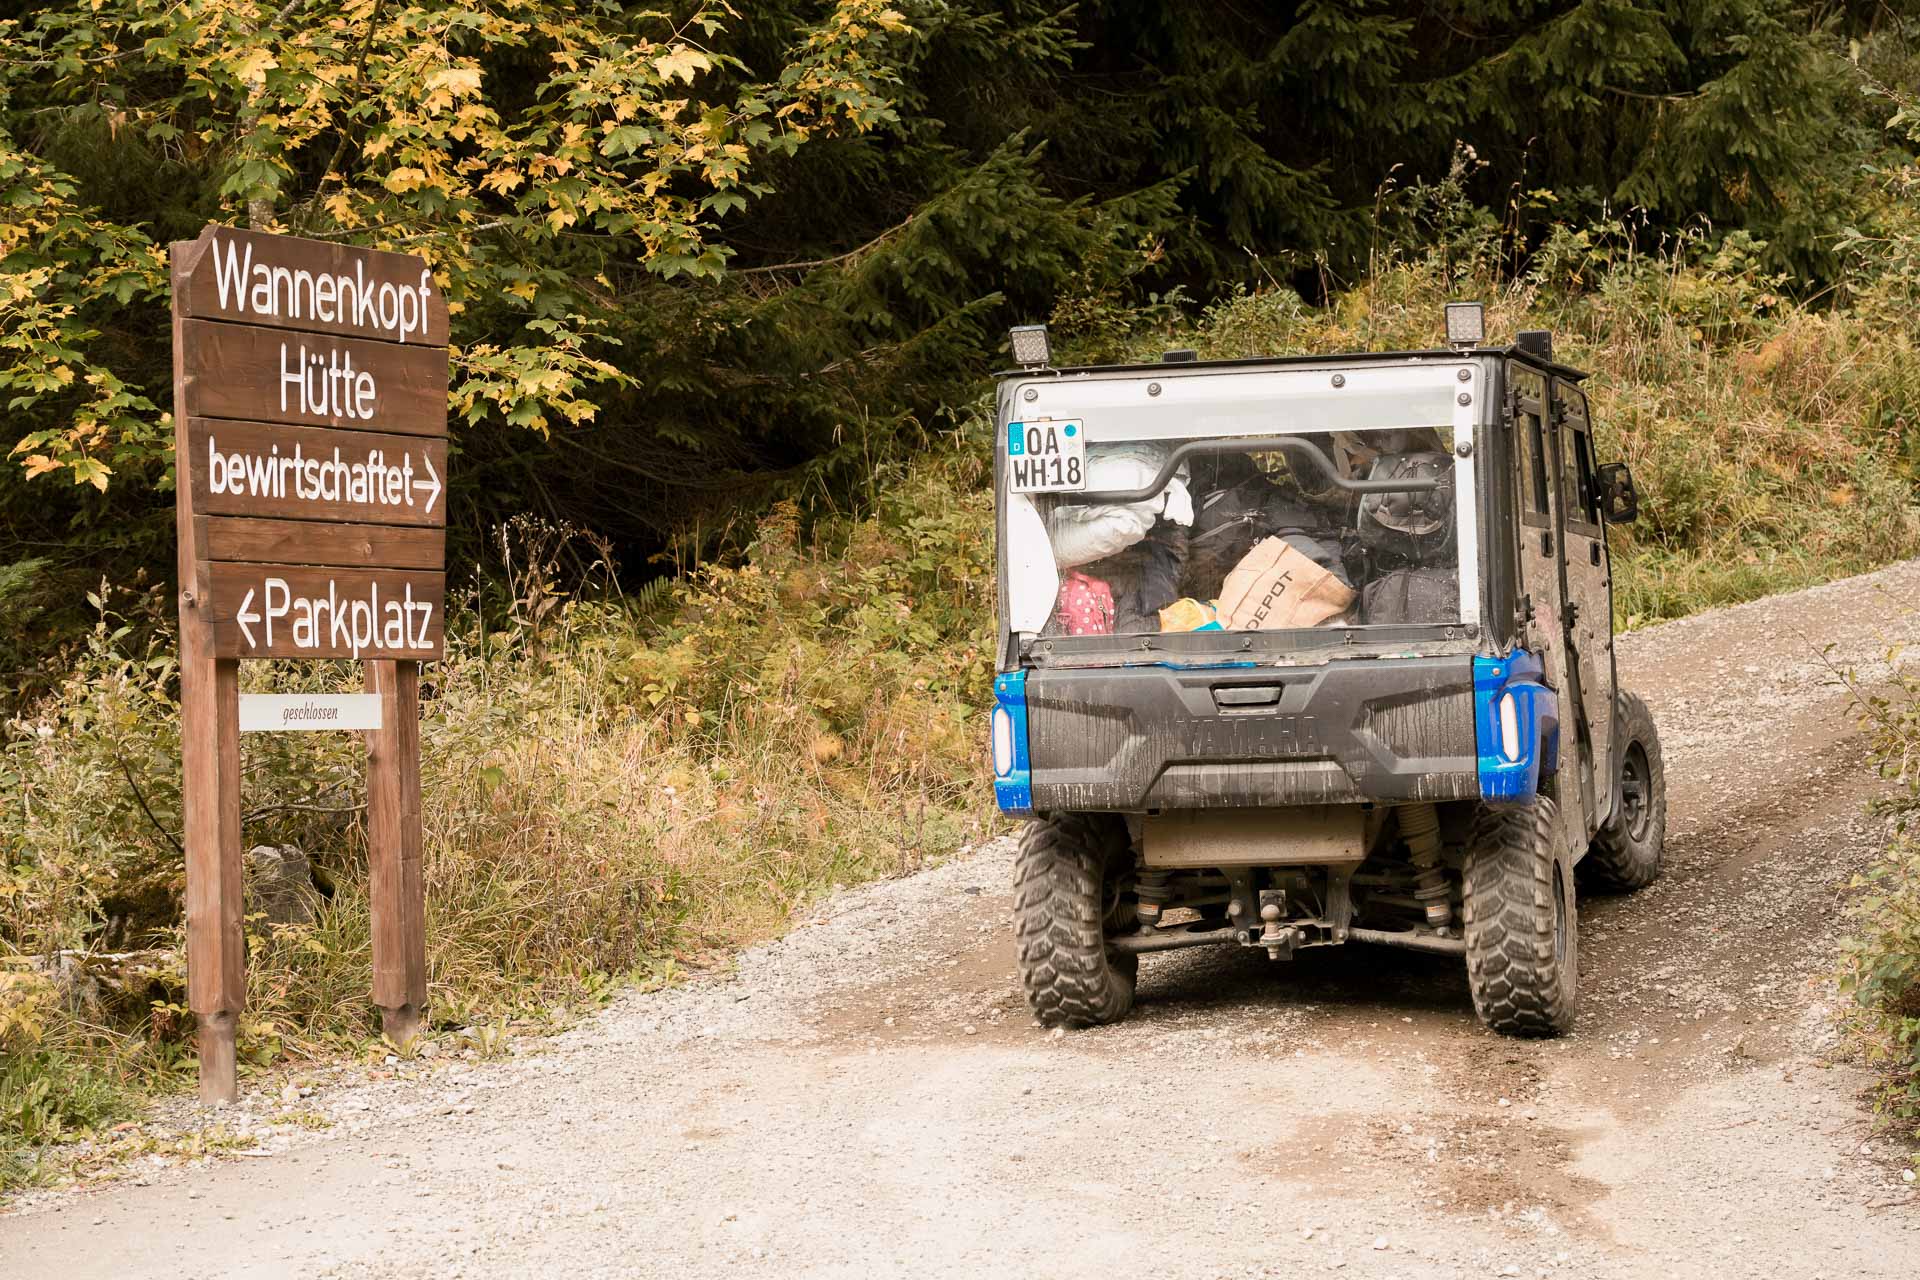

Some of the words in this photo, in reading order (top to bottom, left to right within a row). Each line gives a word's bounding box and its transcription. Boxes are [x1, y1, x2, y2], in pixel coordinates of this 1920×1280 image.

[212, 237, 431, 342] Wannenkopf
[280, 342, 376, 419] Hütte
[209, 435, 414, 506] bewirtschaftet
[1027, 427, 1059, 455] OA
[265, 577, 434, 660] Parkplatz
[283, 701, 338, 726] geschlossen
[1175, 716, 1323, 756] YAMAHA
